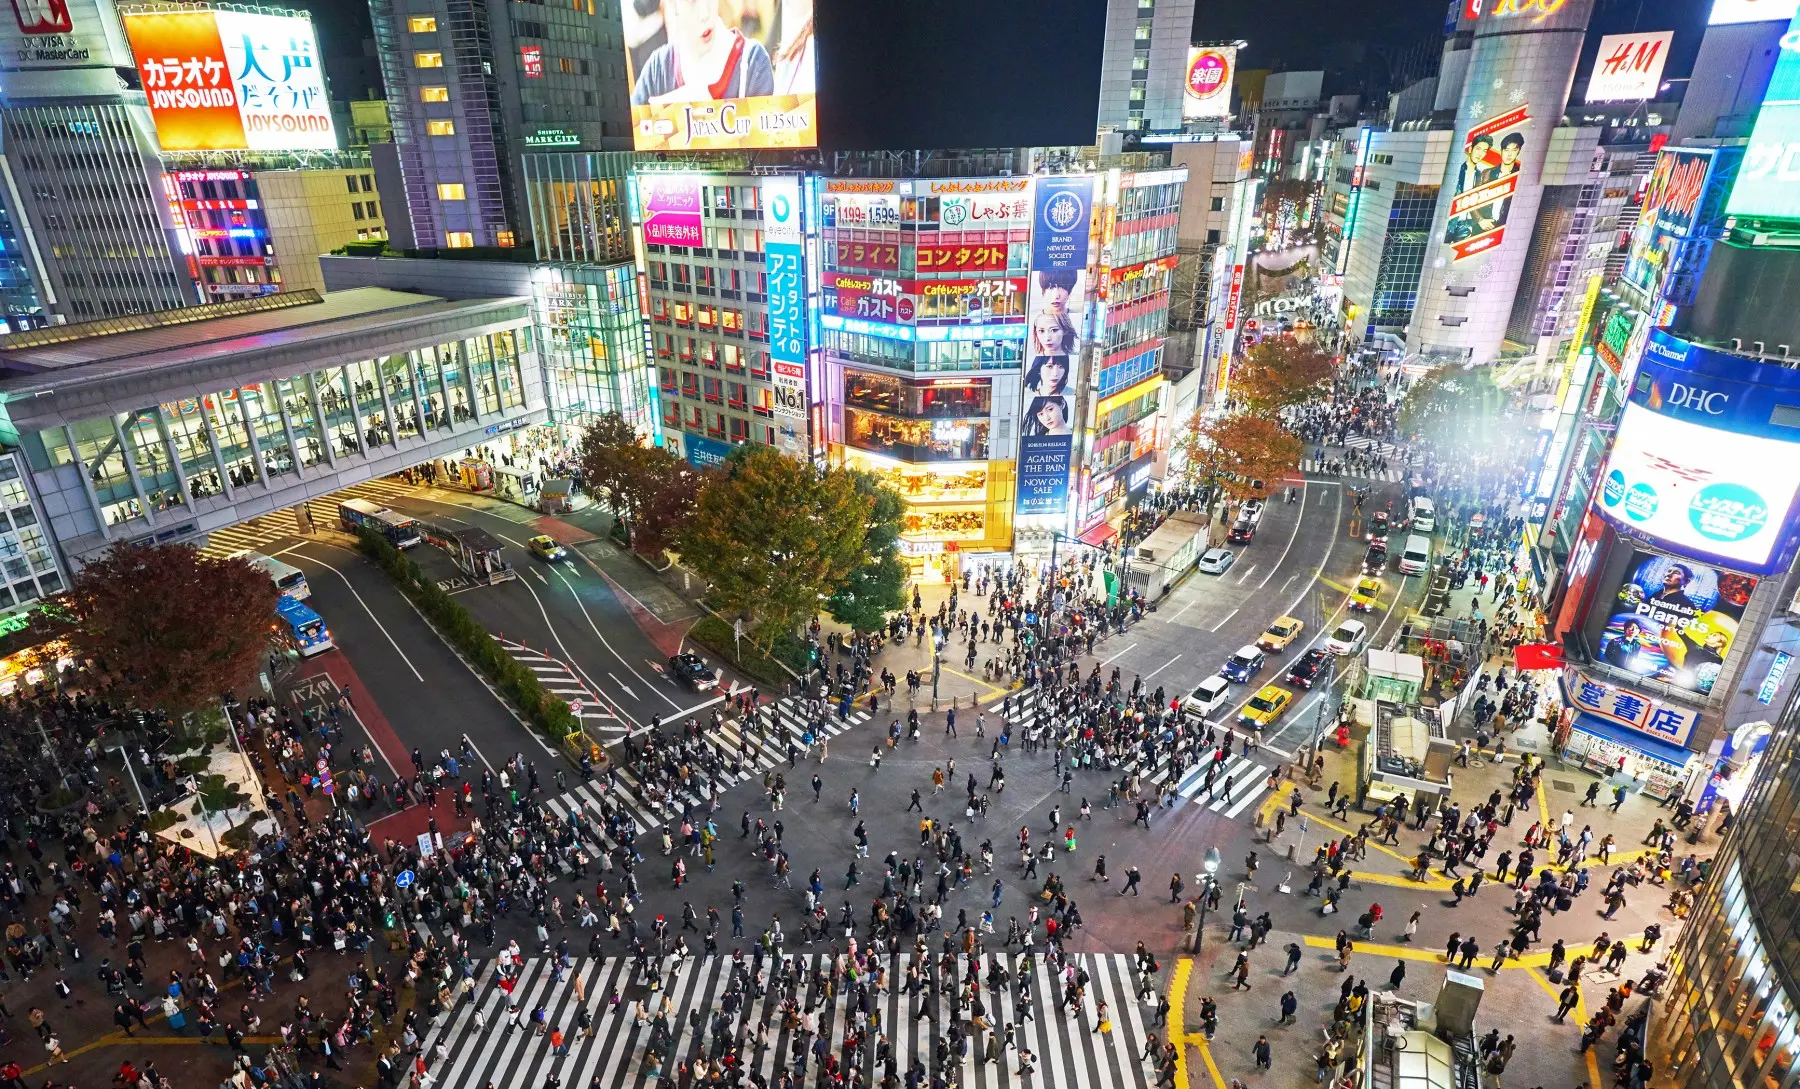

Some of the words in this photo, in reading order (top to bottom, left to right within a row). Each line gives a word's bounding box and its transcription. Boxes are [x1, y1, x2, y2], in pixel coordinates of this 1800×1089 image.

[41, 36, 65, 48] VISA
[36, 48, 90, 60] MasterCard
[1601, 40, 1662, 75] H&M
[144, 56, 224, 87] カラオケ
[1191, 67, 1223, 85] 楽園
[151, 88, 234, 109] JOYSOUND
[247, 114, 330, 132] JOYSOUND
[525, 135, 553, 144] MARK
[554, 134, 578, 143] CITY
[179, 172, 205, 181] カラオケ
[930, 180, 1028, 193] しゃぶしゃぶバイキング
[666, 195, 694, 207] クリニック
[972, 200, 1028, 219] しゃぶ葉
[823, 205, 835, 216] 9F
[652, 224, 699, 241] 品川美容外科
[768, 226, 795, 237] eyecity
[839, 245, 897, 264] プライス
[918, 247, 1004, 266] コンタクト
[872, 278, 902, 296] ガスト
[976, 280, 1017, 297] ガスト
[770, 253, 787, 353] アイシティ
[787, 255, 800, 354] コンタクトの
[825, 295, 837, 308] 7F
[857, 297, 893, 318] ガスト
[1658, 346, 1687, 362] Channel
[774, 384, 805, 411] No.1
[1667, 382, 1729, 415] DHC
[1027, 455, 1065, 463] AGAINST
[1024, 465, 1042, 473] THE
[1046, 464, 1066, 472] PAIN
[1024, 478, 1047, 487] NOW
[1049, 478, 1064, 486] ON
[1033, 486, 1053, 494] SALE
[1650, 597, 1694, 615] teamLab
[1635, 602, 1709, 633] Planets
